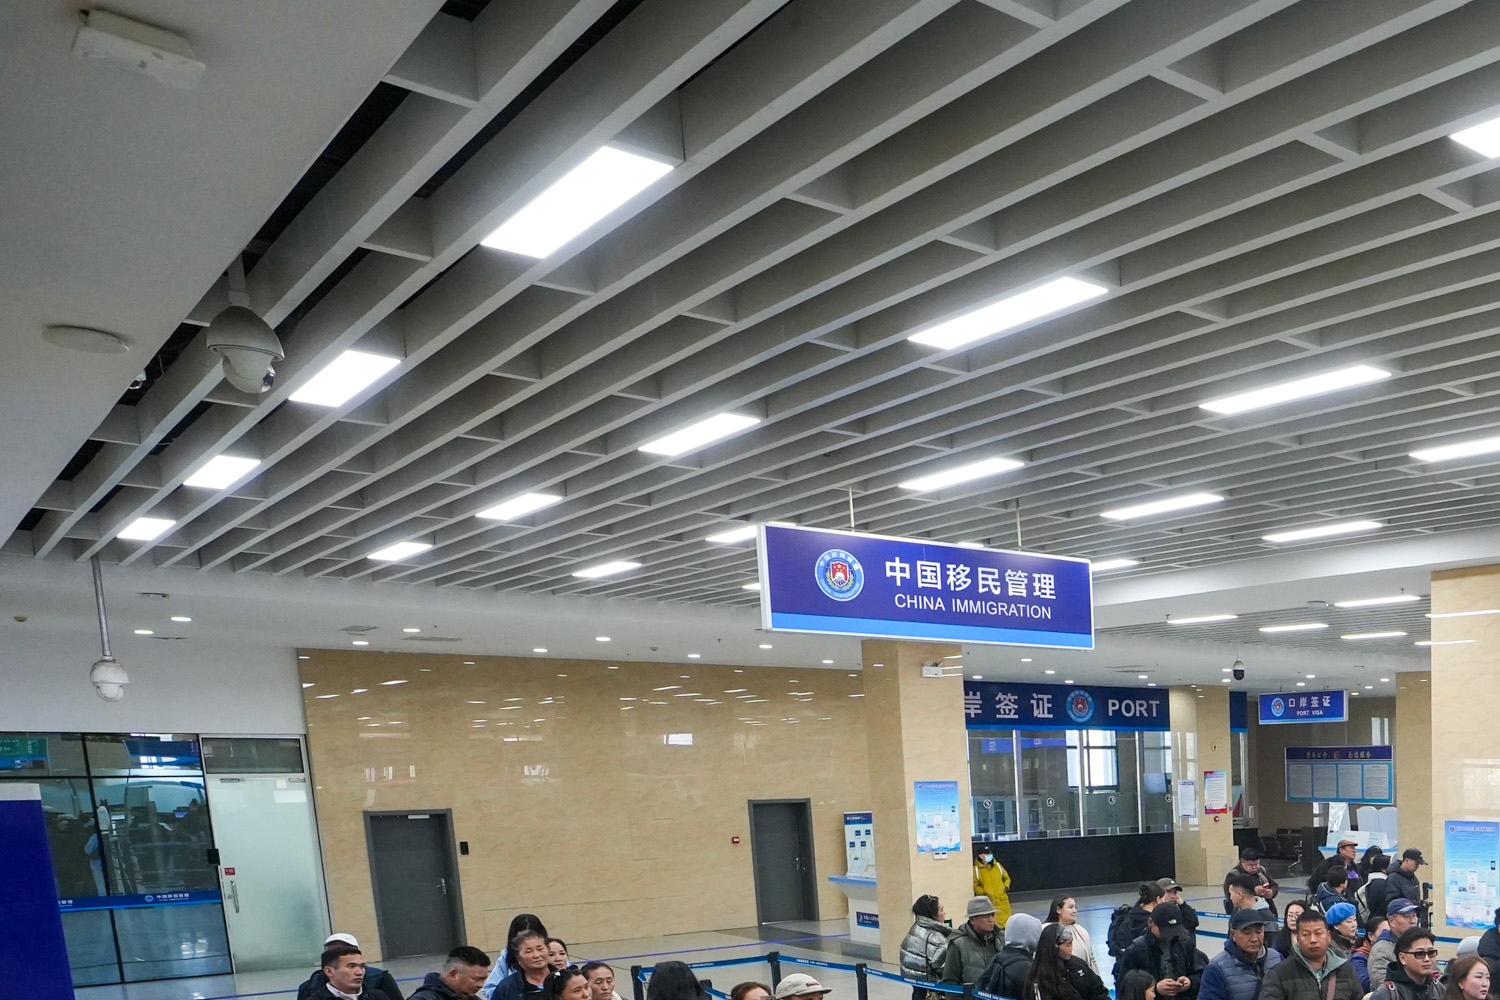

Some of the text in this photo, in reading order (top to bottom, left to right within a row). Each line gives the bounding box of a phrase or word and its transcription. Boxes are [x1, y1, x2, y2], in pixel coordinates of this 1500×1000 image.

[885, 556, 1057, 599] 中国移民管理
[894, 594, 1052, 620] CHINA IMMIGRATION
[964, 691, 1054, 719] 岸签证
[1108, 699, 1160, 717] PORT
[1288, 695, 1331, 708] 口岸签证
